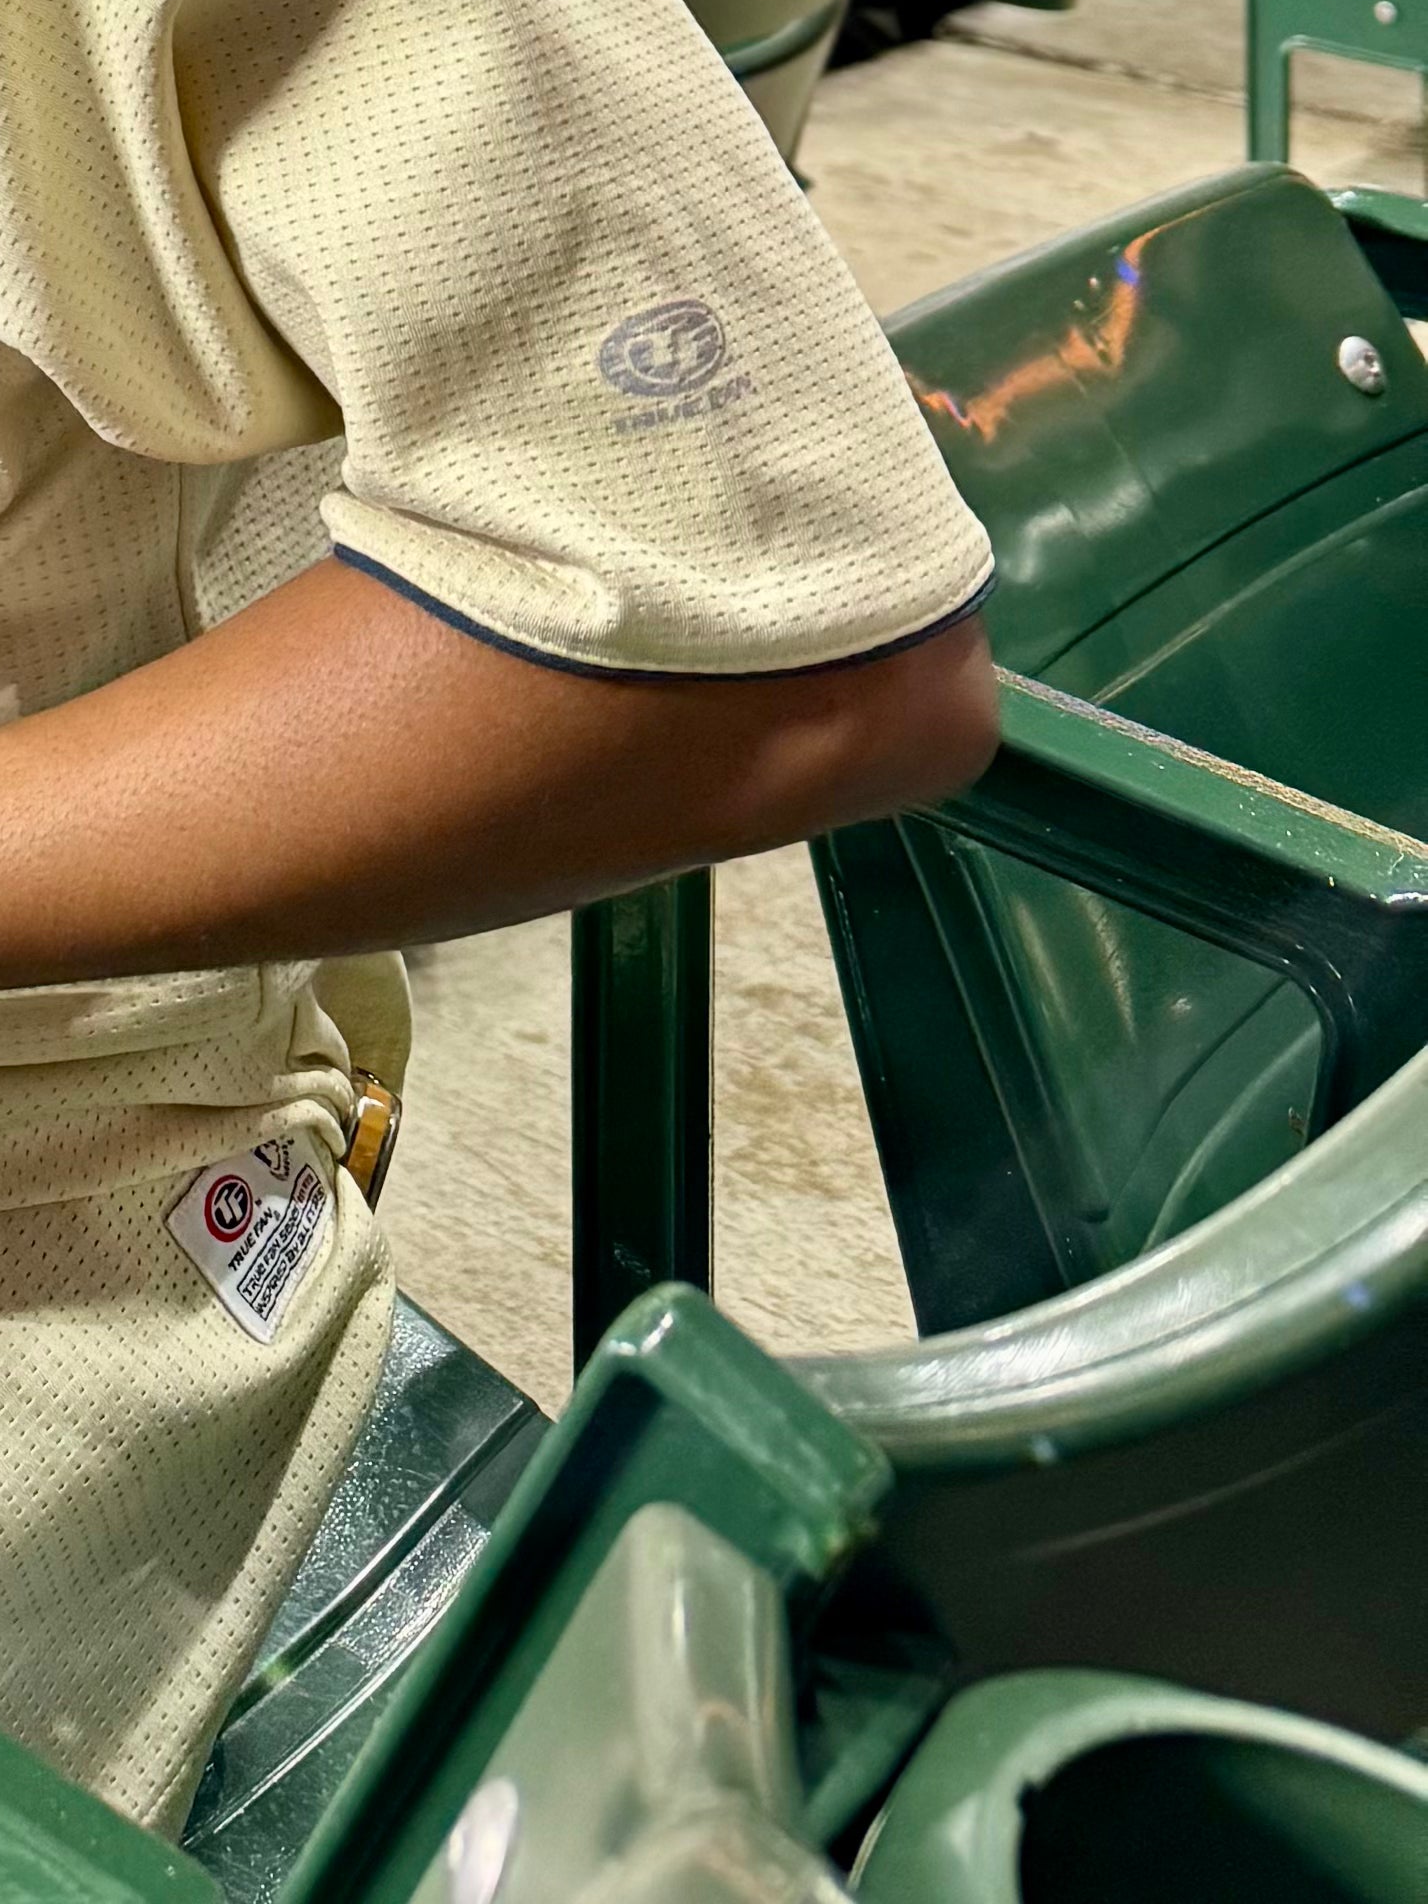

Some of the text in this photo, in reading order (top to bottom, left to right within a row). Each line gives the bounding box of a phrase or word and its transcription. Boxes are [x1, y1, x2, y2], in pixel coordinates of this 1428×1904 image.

[227, 1206, 273, 1272] TRUE FAN
[242, 1263, 267, 1297] TRUE
[263, 1238, 281, 1266] FAN
